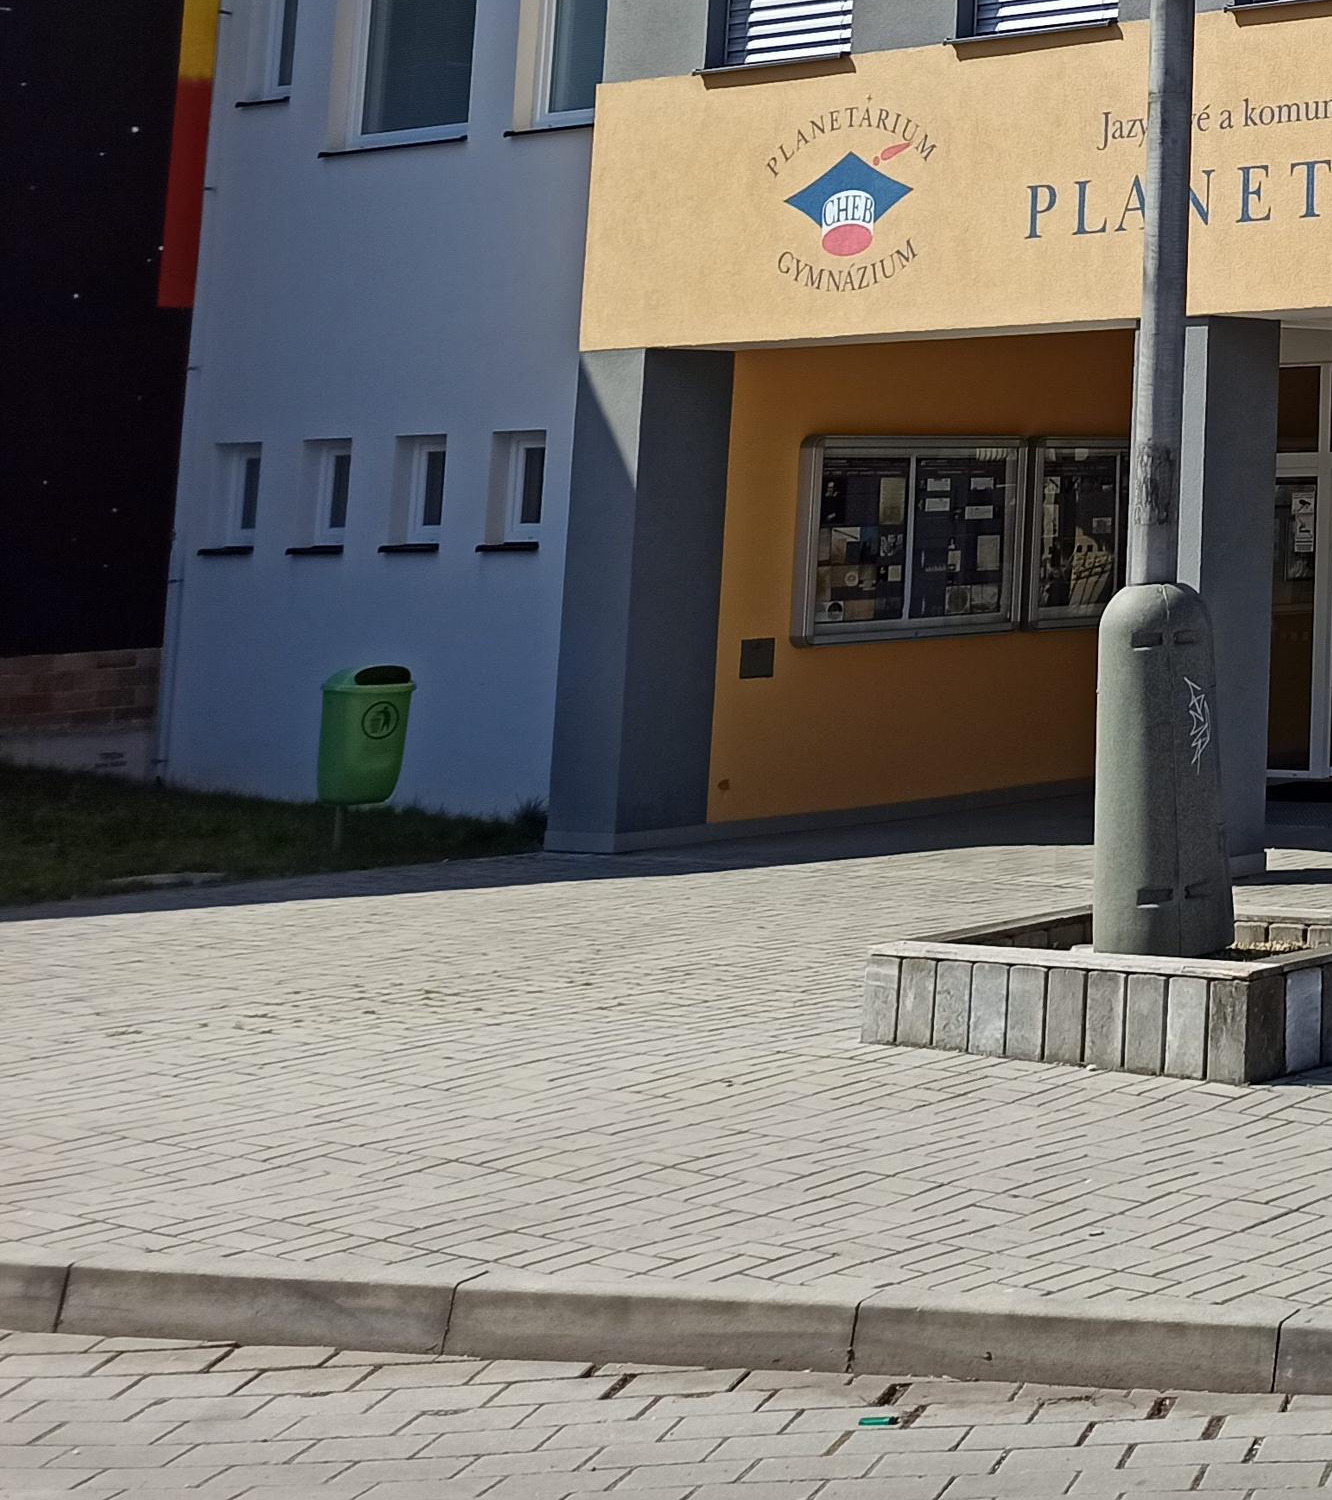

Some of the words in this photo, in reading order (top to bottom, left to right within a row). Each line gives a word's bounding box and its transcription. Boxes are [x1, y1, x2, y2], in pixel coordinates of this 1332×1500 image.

[766, 94, 938, 178] PLANETÁRIUM
[1096, 104, 1210, 151] Jazyé
[1219, 108, 1234, 130] a
[823, 194, 875, 227] CHEB
[777, 238, 918, 293] GYMNÁZIUM
